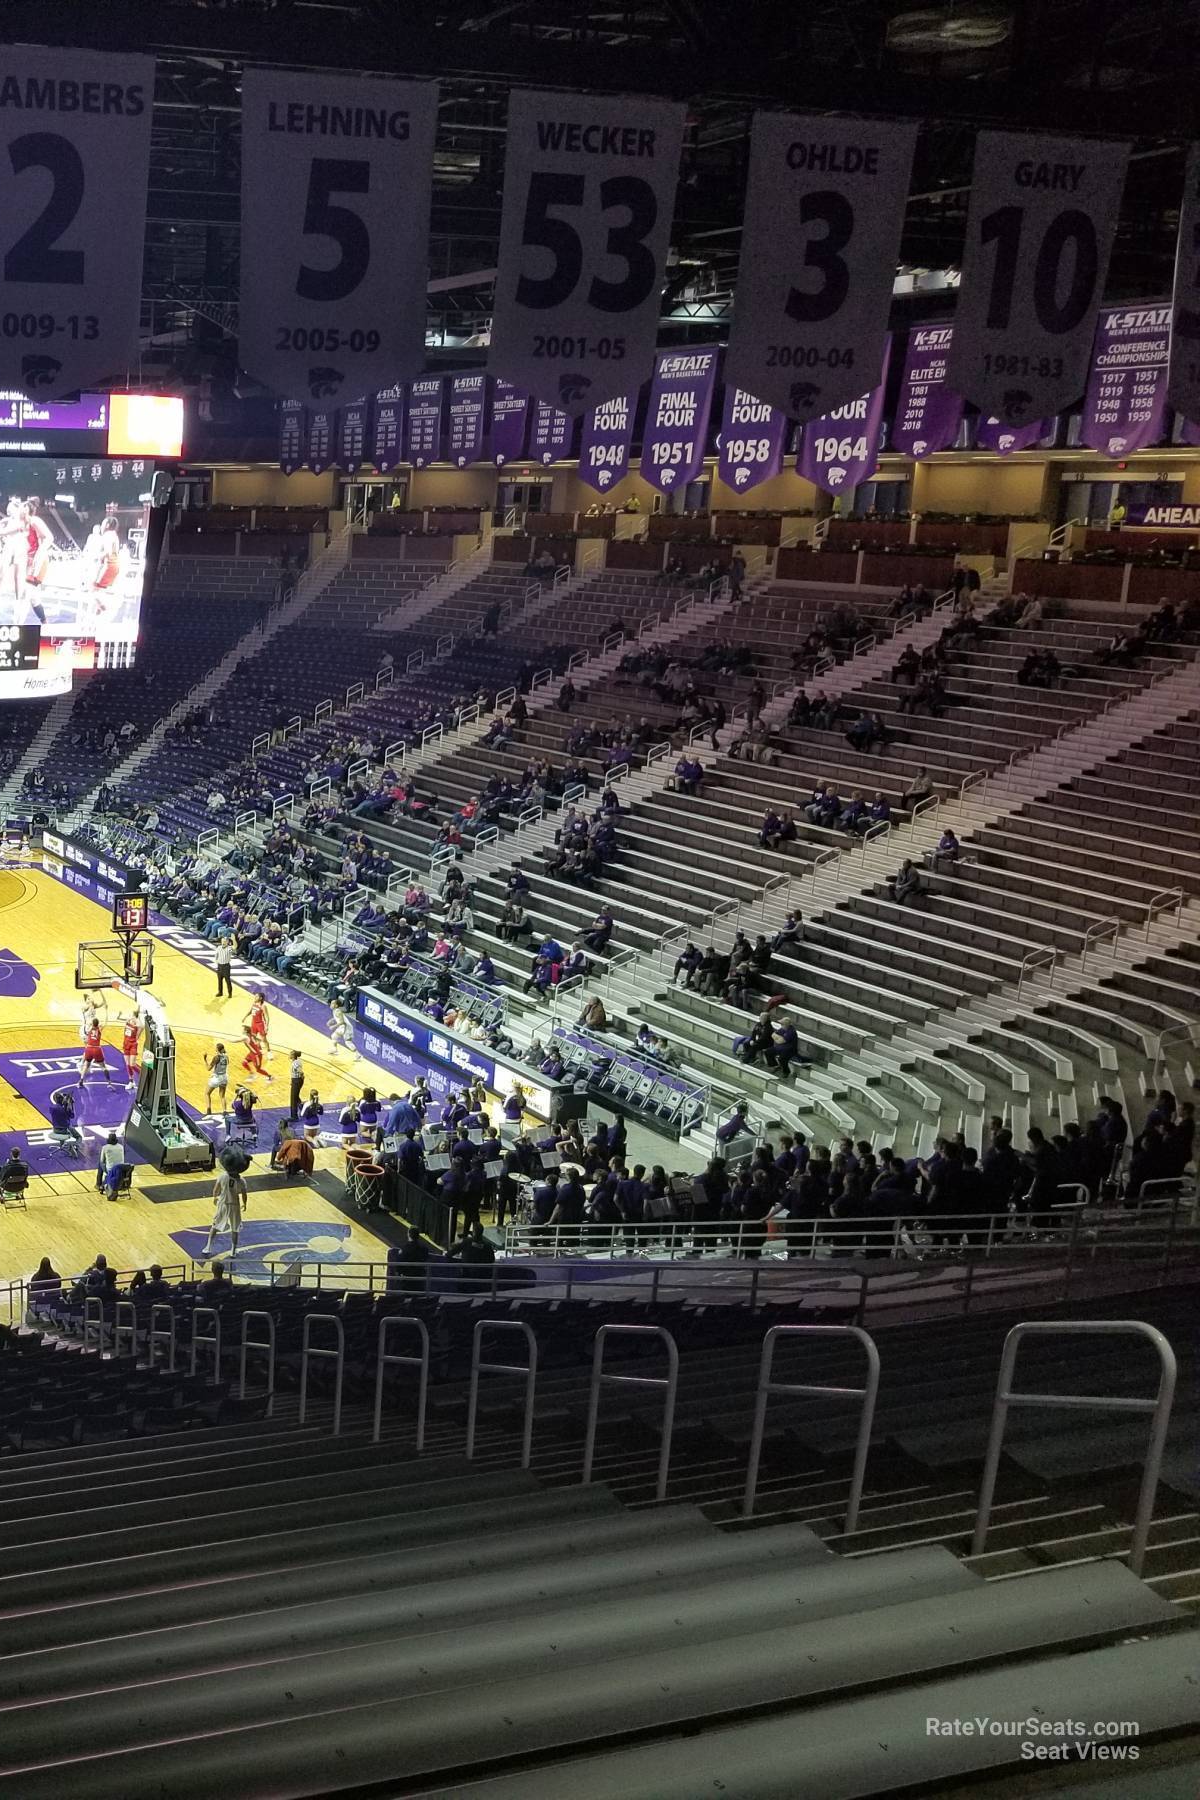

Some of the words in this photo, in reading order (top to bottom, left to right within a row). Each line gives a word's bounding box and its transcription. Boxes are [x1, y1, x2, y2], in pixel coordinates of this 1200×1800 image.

[268, 102, 410, 141] LEHNING
[536, 121, 655, 158] WECKER
[785, 142, 879, 175] OHLDE
[1014, 161, 1086, 192] GARY
[4, 132, 85, 284] 2
[296, 158, 370, 302] 5
[514, 172, 658, 313] 53
[784, 190, 854, 322] 3
[981, 206, 1098, 334] 10
[275, 327, 381, 352] 2005-09
[914, 329, 953, 345] K-STA
[532, 336, 626, 360] 2001-05
[1108, 341, 1166, 354] CONFERENCE
[660, 354, 712, 372] K-STATE
[766, 345, 854, 370] 2000-04
[930, 360, 946, 368] NCAA
[983, 354, 1063, 378] 1981-83
[1096, 350, 1170, 365] CHAMPIONSHIPS
[454, 376, 483, 389] K-STATE
[676, 370, 705, 378] BASKETBALL
[910, 369, 933, 380] ELITE
[1102, 373, 1126, 383] 1917
[1135, 371, 1157, 381] 1951
[412, 380, 440, 392] K-STATE
[911, 386, 928, 395] 1981
[1099, 386, 1123, 396] 1919
[1133, 384, 1155, 394] 1956
[595, 397, 629, 414] FINAL
[659, 391, 697, 410] FINAL
[908, 398, 926, 407] 1988
[1097, 400, 1120, 409] 1948
[1130, 398, 1153, 408] 1958
[593, 414, 627, 431] FOUR
[656, 409, 695, 427] FOUR
[732, 405, 772, 424] FOUR
[905, 410, 923, 419] 2010
[1094, 412, 1117, 422] 1950
[1128, 411, 1151, 421] 1959
[902, 421, 921, 430] 2018
[589, 445, 625, 466] 1948
[652, 442, 694, 464] 1951
[726, 439, 770, 463] 1958
[815, 437, 868, 462] 1964
[132, 462, 144, 472] 44
[126, 909, 141, 926] 13
